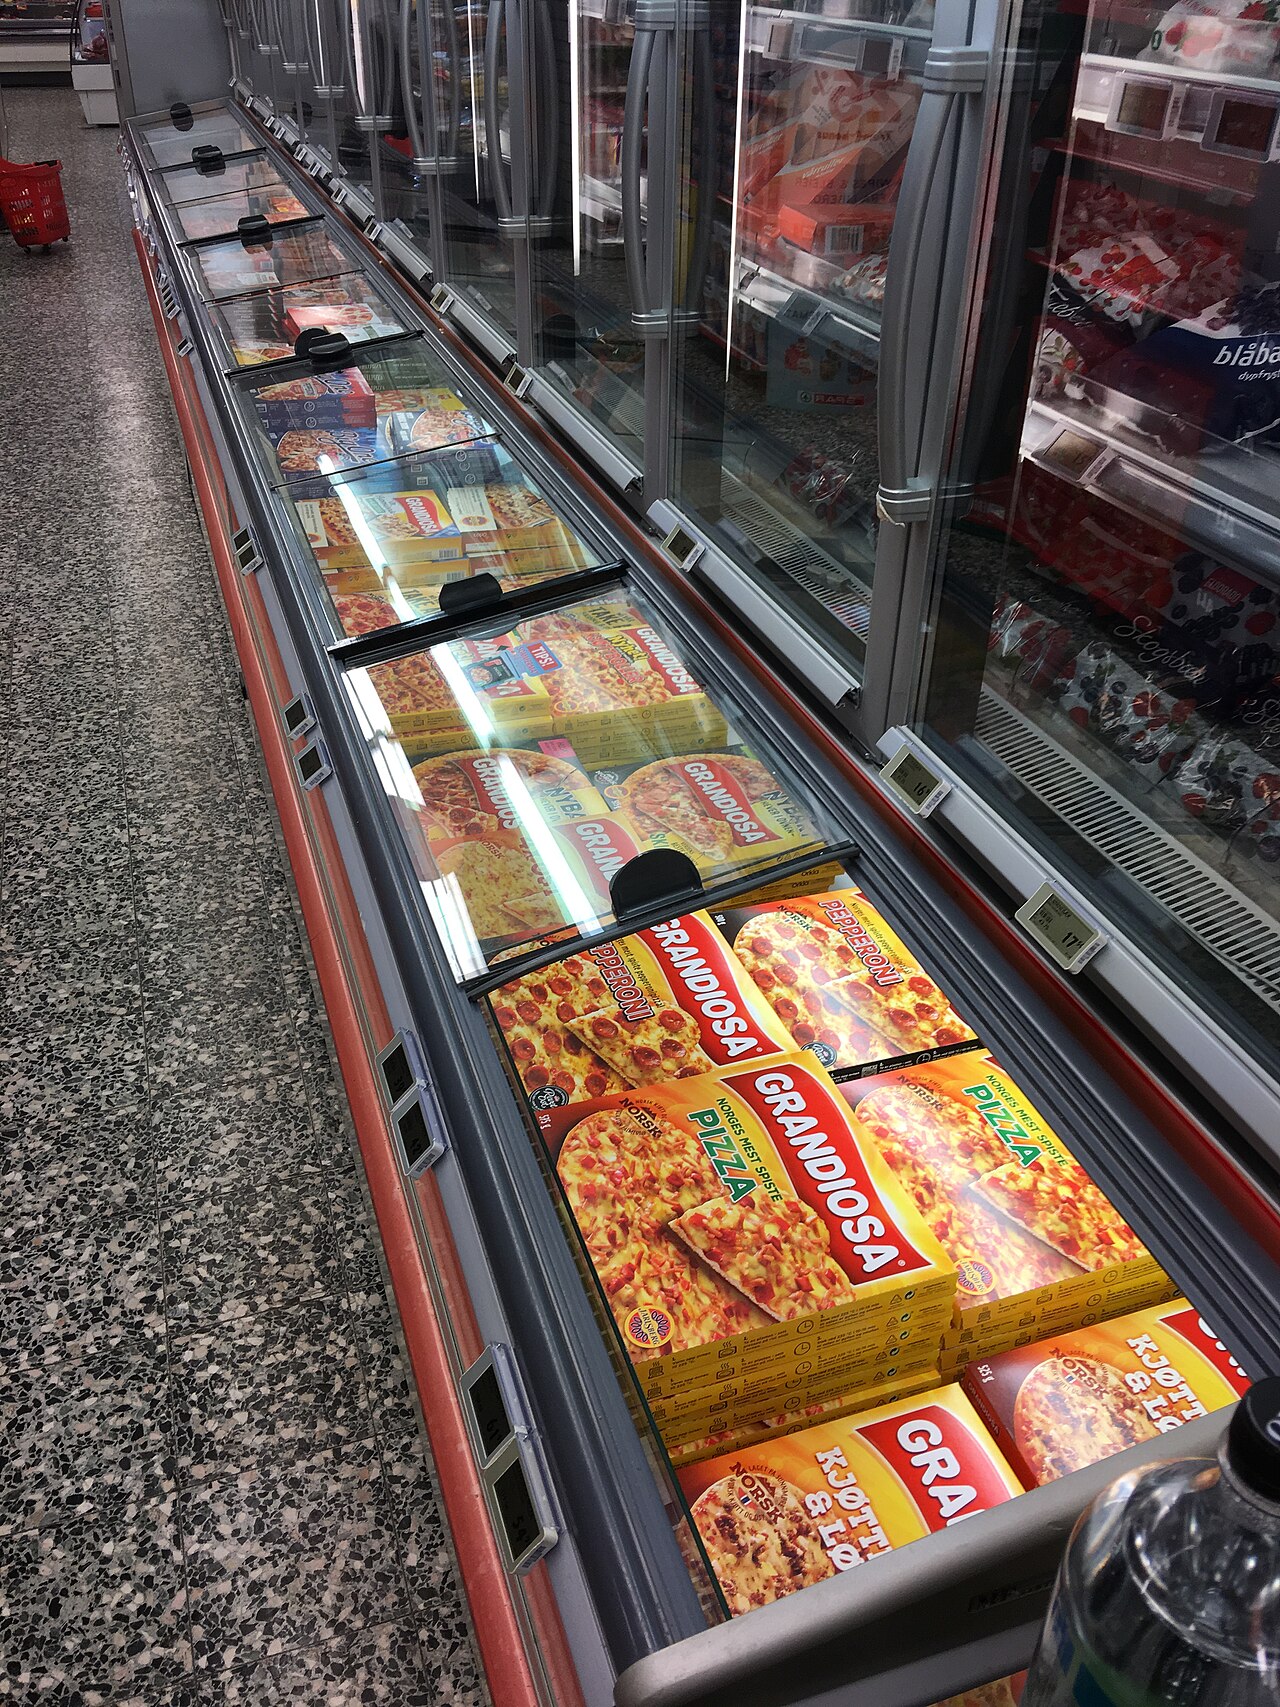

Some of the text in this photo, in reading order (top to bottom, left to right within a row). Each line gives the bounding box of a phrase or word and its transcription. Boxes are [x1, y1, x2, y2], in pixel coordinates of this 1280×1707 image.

[529, 645, 557, 669] TIPS!
[637, 627, 697, 694] GRANDIOSA
[684, 761, 767, 843] GRANDIOSA
[776, 903, 815, 933] NORSK
[818, 899, 904, 986] PEPPERONI
[649, 917, 759, 1058] GRANDIOSA
[618, 1097, 664, 1139] NORSK
[687, 1108, 759, 1204] PIZZA
[716, 1096, 784, 1203] NORGES MEST SPISTE
[963, 1083, 1044, 1169] PIZZA
[985, 1073, 1069, 1168] NORGES MEST SPISTE
[755, 1070, 900, 1274] GRANDIOSA
[638, 1308, 661, 1346] JARLSBERG
[1049, 1347, 1111, 1400] NORSK
[1124, 1370, 1151, 1394] &
[1125, 1333, 1208, 1421] KJØTT
[729, 1461, 786, 1525] NORSK
[815, 1446, 893, 1561] KJØTT
[896, 1418, 988, 1527] GRA
[804, 1490, 866, 1571] & LØ
